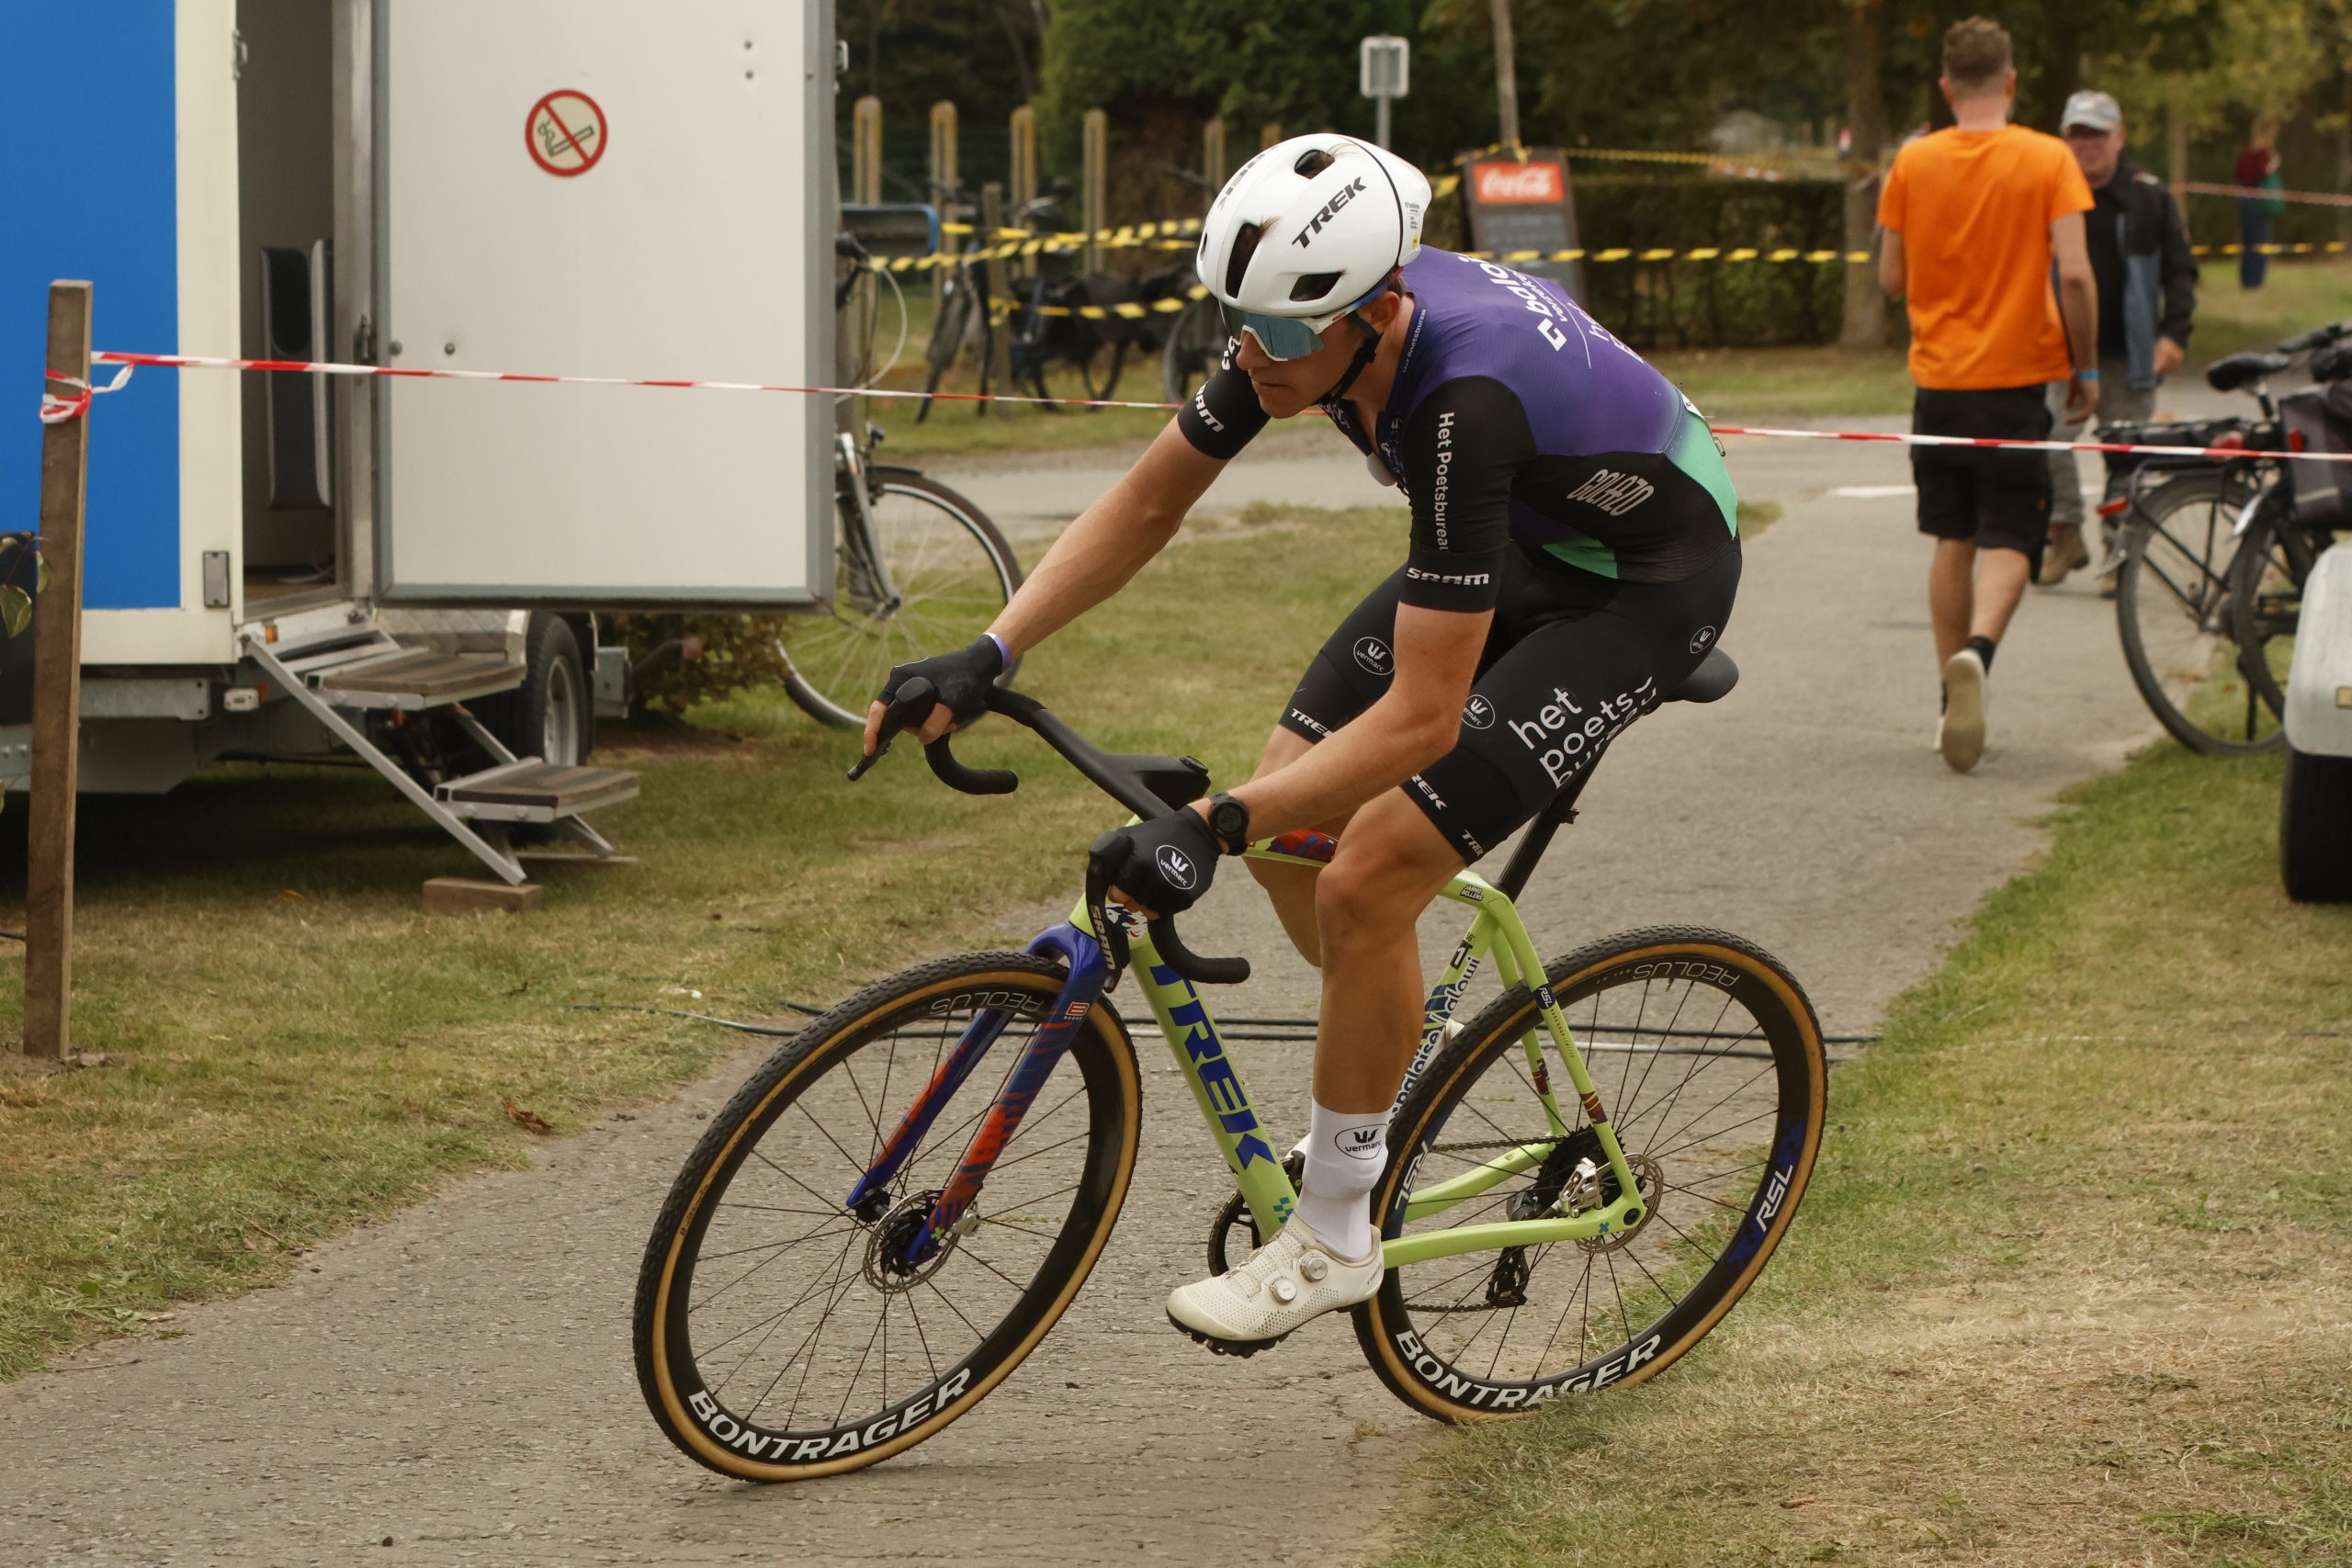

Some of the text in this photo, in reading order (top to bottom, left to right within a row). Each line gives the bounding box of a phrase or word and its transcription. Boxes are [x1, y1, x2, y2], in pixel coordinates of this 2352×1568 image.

[1292, 175, 1367, 249] TREK
[1194, 380, 1226, 433] RAM
[1437, 412, 1455, 448] Het
[1566, 468, 1655, 516] GOLAZO
[1406, 567, 1490, 586] SRAM
[1356, 649, 1385, 672] vermarc
[1463, 706, 1483, 727] ermarc
[1508, 687, 1583, 750] het
[1539, 693, 1634, 786] poets
[1411, 773, 1448, 811] REK
[1160, 858, 1188, 886] vermarc
[1091, 904, 1116, 970] SRAM
[1633, 962, 1741, 987] AEOLUS
[930, 991, 1045, 1015] AEOLUS
[1539, 987, 1554, 1009] RSL
[1149, 964, 1277, 1171] TREK
[1345, 1139, 1382, 1152] vermarc
[1756, 1164, 1794, 1233] RSL
[1396, 1329, 1661, 1408] BONTRAGER
[688, 1367, 971, 1461] BONTRAGER
